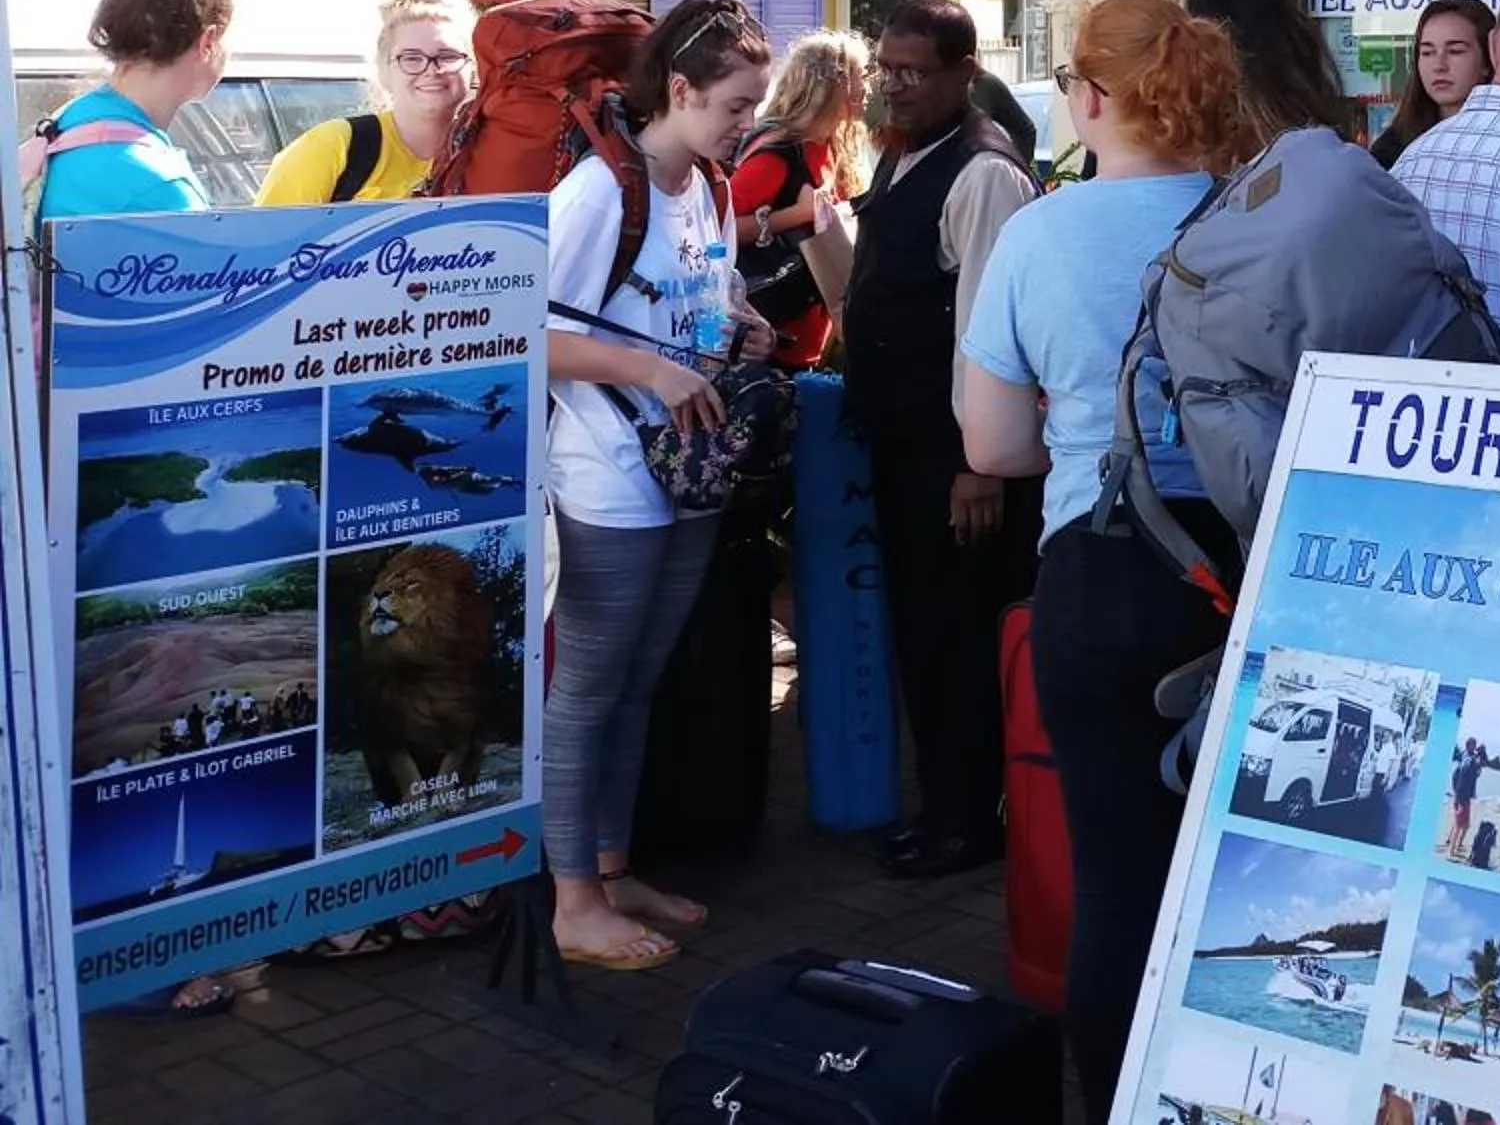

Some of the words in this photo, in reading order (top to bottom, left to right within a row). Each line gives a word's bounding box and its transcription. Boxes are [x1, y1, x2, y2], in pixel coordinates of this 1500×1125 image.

[94, 251, 277, 304] Monalysa
[288, 241, 369, 281] Tour
[376, 236, 497, 288] Operator
[429, 278, 481, 295] HAPPY
[485, 274, 535, 291] MORIS
[293, 318, 346, 348] Last
[355, 308, 415, 339] week
[423, 305, 491, 336] promo
[203, 359, 285, 392] Promo
[295, 352, 325, 382] de
[333, 340, 433, 377] dernière
[440, 333, 529, 364] semaine
[176, 400, 209, 421] AUX
[213, 396, 264, 418] CERFS
[336, 499, 409, 525] DAUPHINS
[411, 496, 421, 511] &
[359, 520, 389, 538] AUX
[391, 508, 461, 535] BENITIERS
[1288, 531, 1378, 589] ILE
[1383, 550, 1491, 609] AUX
[158, 593, 192, 613] SUD
[195, 584, 248, 607] OUEST
[96, 781, 121, 802] ÎLE
[125, 771, 176, 796] PLATE
[180, 766, 191, 782] &
[195, 756, 230, 781] ÎLOT
[232, 743, 297, 772] GABRIEL
[410, 771, 460, 797] CASELA
[369, 796, 428, 826] MARCHE
[429, 787, 466, 812] AVEC
[468, 777, 499, 800] LION
[76, 898, 278, 986] enseignement
[304, 850, 449, 917] Reservation
